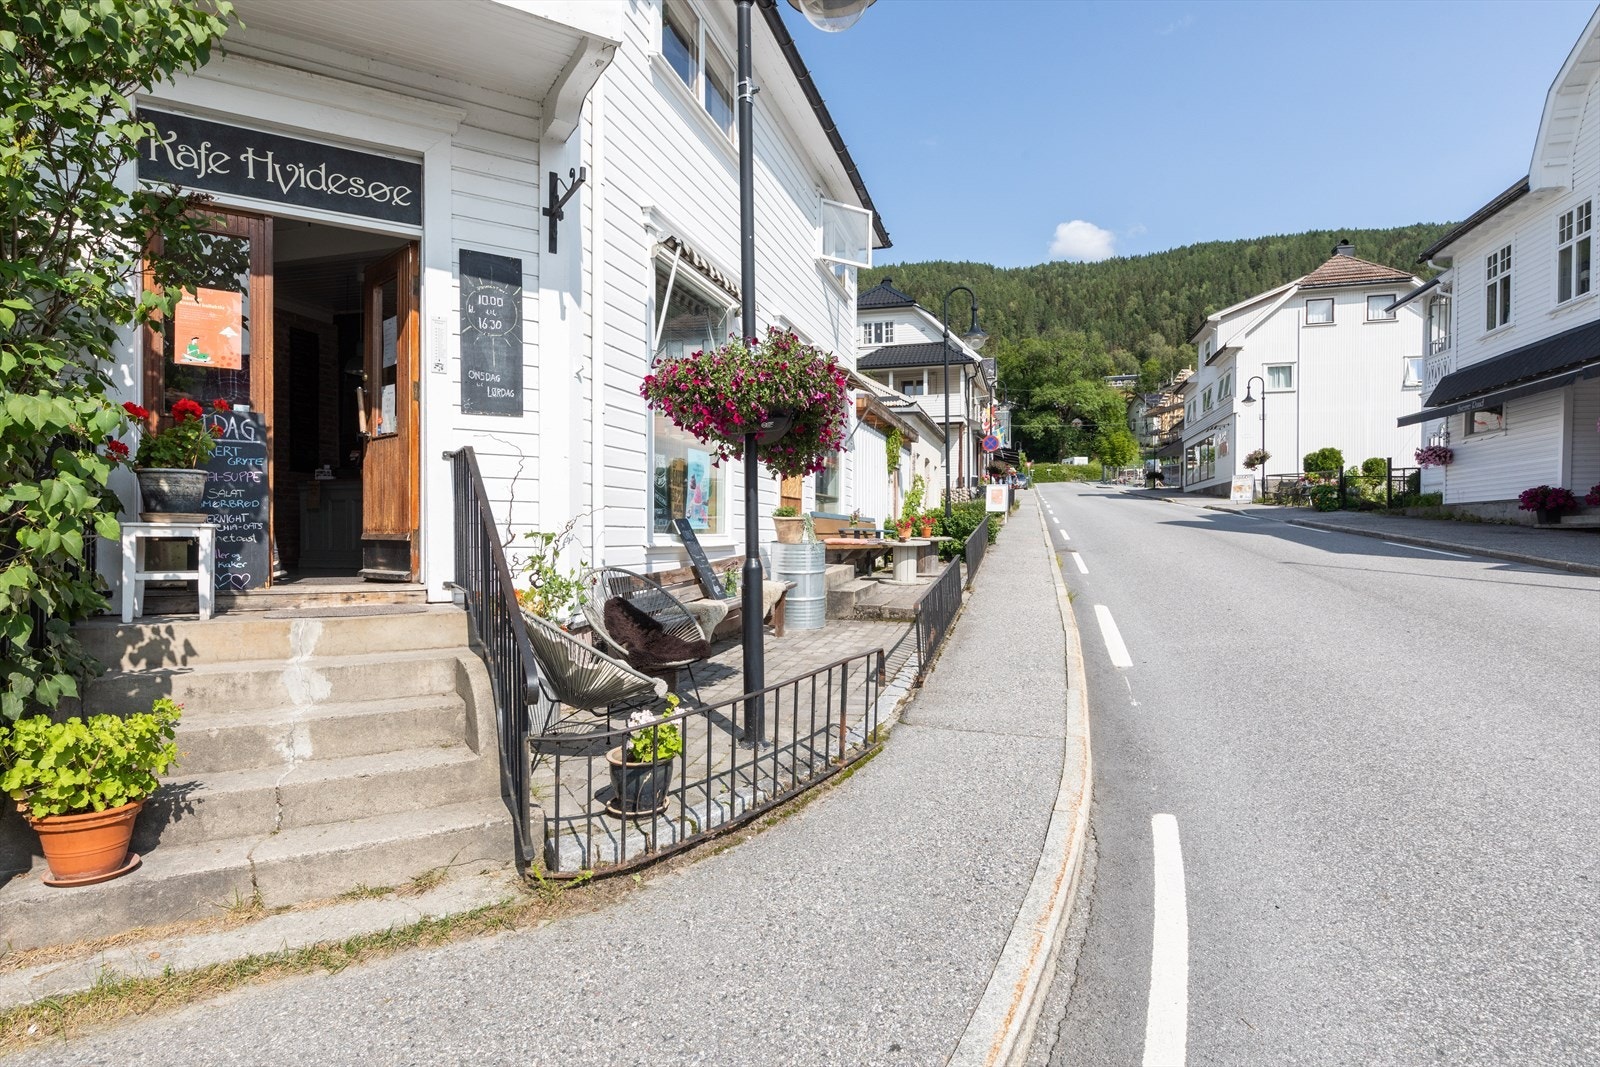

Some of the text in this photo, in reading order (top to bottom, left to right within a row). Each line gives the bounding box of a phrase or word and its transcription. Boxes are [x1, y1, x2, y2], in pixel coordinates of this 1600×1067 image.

[149, 128, 413, 207] Kafe Hvidesøe
[468, 370, 501, 382] ONSDAG
[487, 386, 515, 398] LØRDAG
[213, 414, 255, 441] DAG
[227, 457, 264, 466] GRYTE
[205, 470, 264, 483] AI-SUPPE
[207, 486, 245, 499] SALAT
[206, 513, 249, 524] ERNIGHT
[215, 533, 258, 543] netoast
[214, 548, 243, 561] ller og
